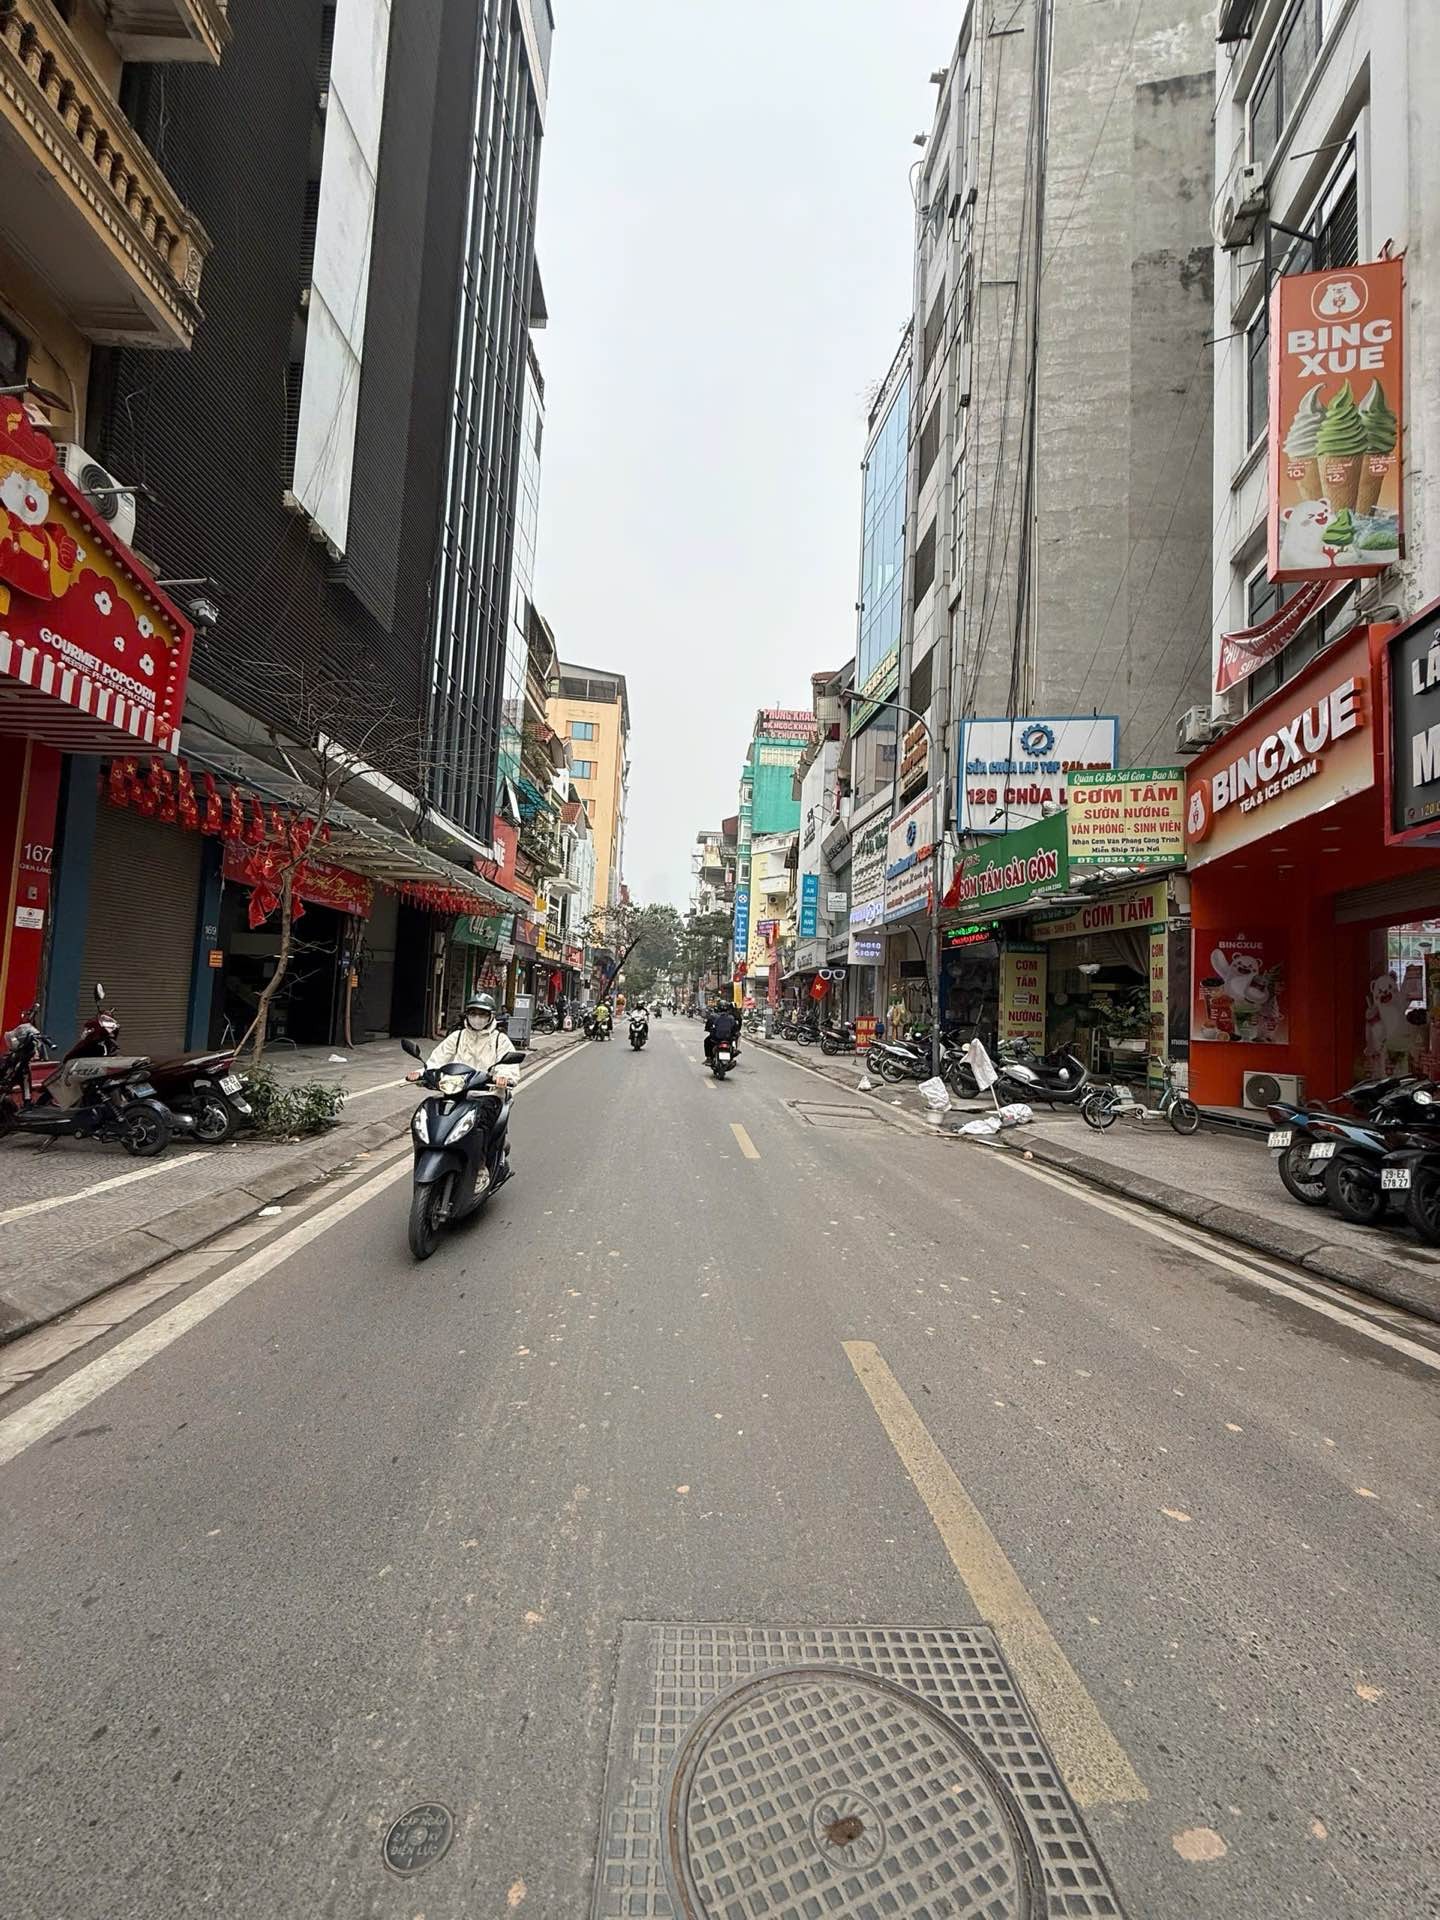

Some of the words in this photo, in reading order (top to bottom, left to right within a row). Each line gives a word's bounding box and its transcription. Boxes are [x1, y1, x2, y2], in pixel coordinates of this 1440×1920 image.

[1288, 319, 1392, 354] BING
[1297, 345, 1384, 378] XUE
[40, 627, 102, 672] GOURMET
[102, 662, 156, 704] POPCORN
[1212, 677, 1361, 813] BINGXUE
[1019, 761, 1039, 775] LAP
[1073, 788, 1122, 804] CƠM
[1130, 782, 1178, 802] TẤM
[1239, 799, 1257, 814] TEA
[1256, 792, 1264, 803] &
[1265, 782, 1281, 800] ICE
[1281, 759, 1317, 790] CREAM
[1071, 822, 1090, 835] VĂN
[1092, 821, 1124, 835] PHÒNG
[1133, 822, 1157, 834] SINH
[1160, 819, 1181, 832] VIÊN
[1084, 806, 1120, 820] SƯỜN
[1124, 806, 1170, 819] NƯỚNG
[24, 843, 54, 863] 167
[979, 860, 1004, 896] TẤM
[1004, 856, 1026, 888] SÀI
[1027, 848, 1059, 884] GÒN
[1083, 903, 1114, 929] CƠM
[1120, 891, 1154, 922] TẤM
[1218, 941, 1264, 949] BINGXUE
